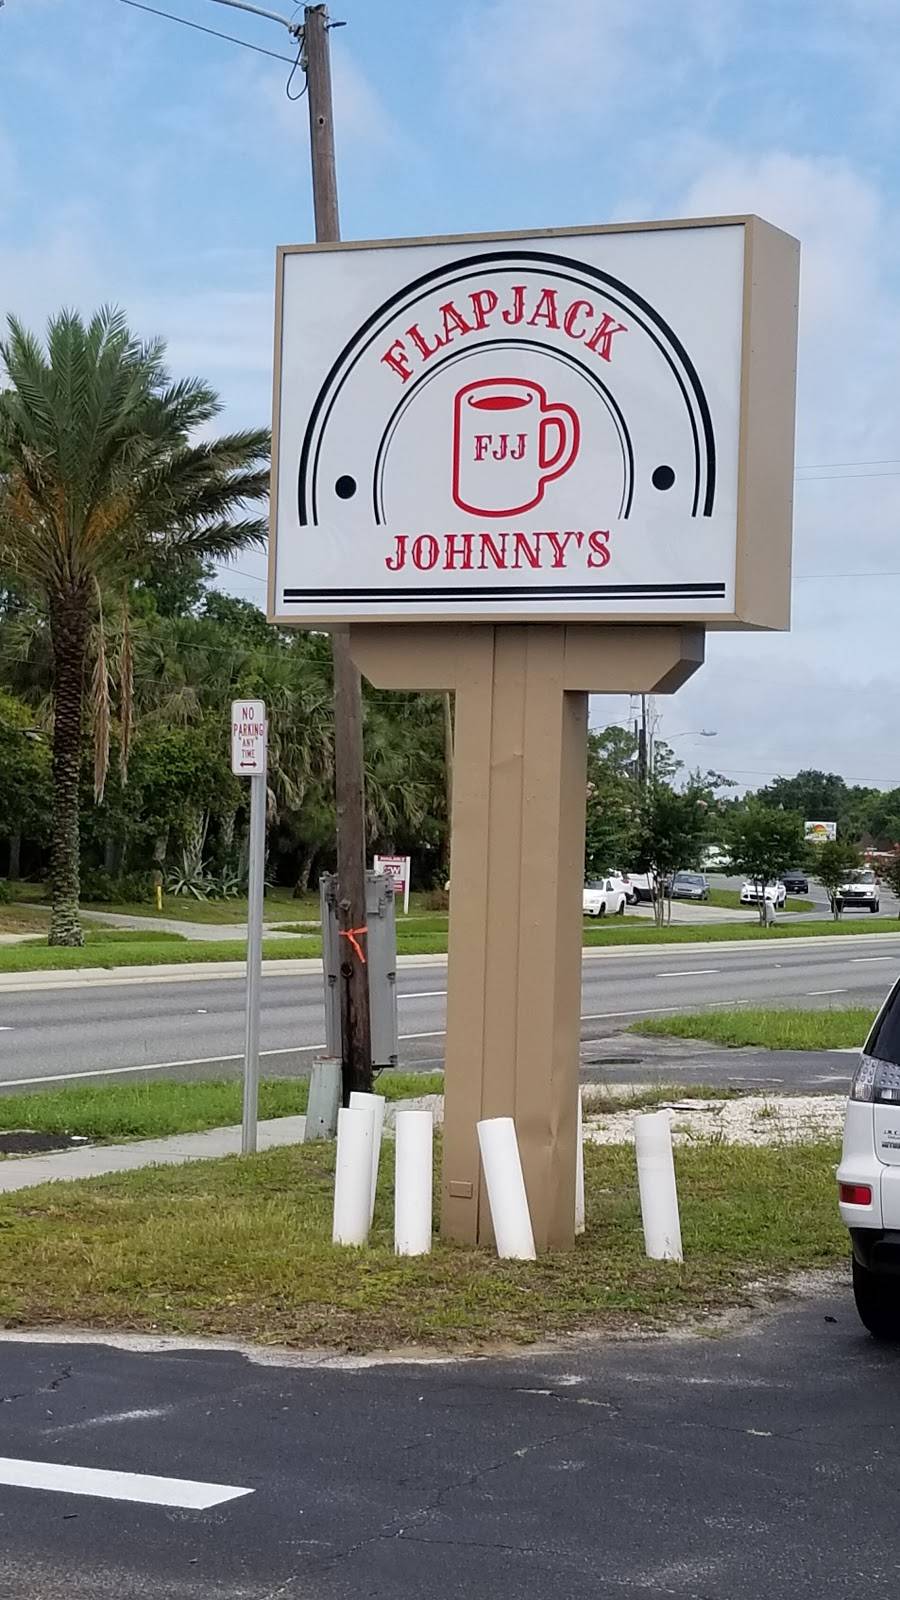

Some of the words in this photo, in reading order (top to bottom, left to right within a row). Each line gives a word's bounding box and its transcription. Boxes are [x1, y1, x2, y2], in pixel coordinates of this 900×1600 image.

[382, 285, 628, 383] FLAPJACK
[474, 433, 528, 462] FJJ
[385, 530, 611, 571] JOHNNY'S
[242, 706, 255, 720] NO
[233, 723, 264, 736] PARKING
[241, 749, 255, 758] TIME
